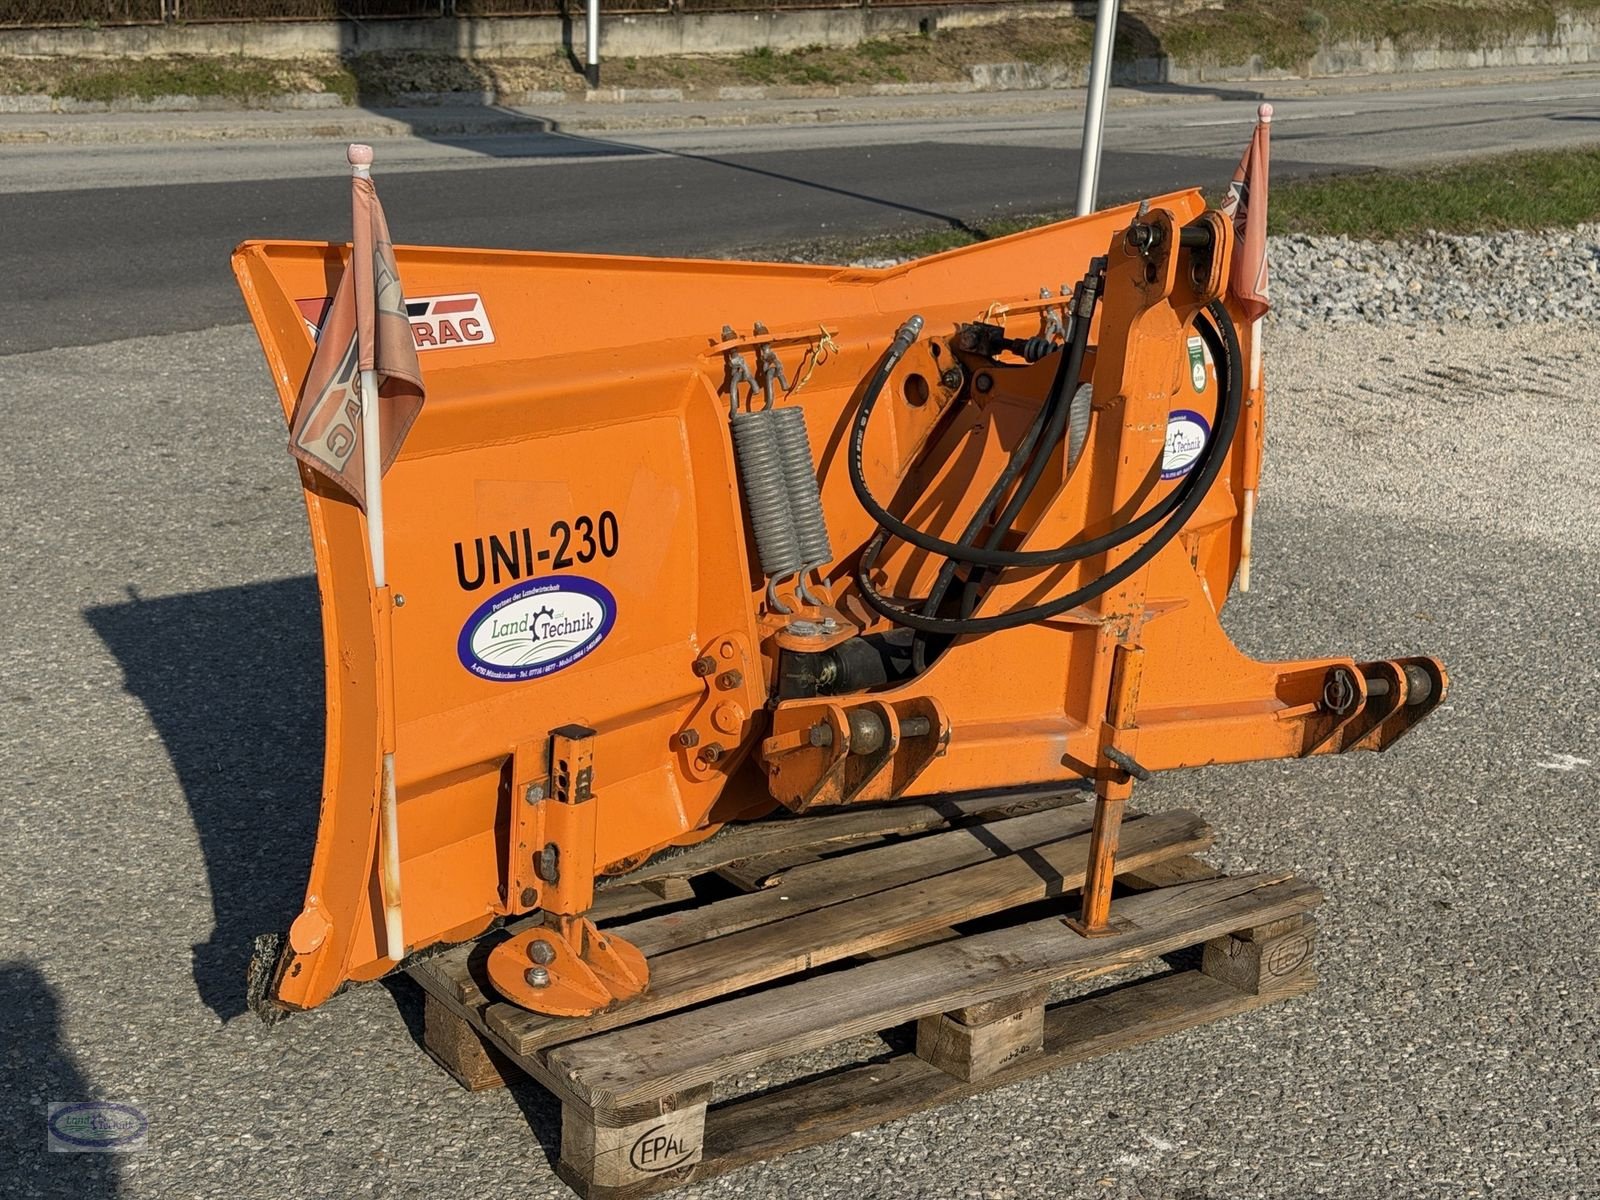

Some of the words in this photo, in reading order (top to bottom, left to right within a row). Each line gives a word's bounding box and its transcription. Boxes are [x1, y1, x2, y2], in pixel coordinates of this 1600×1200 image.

[411, 318, 484, 346] RAC
[454, 511, 618, 591] UNI-230
[492, 597, 512, 611] Partner
[512, 593, 522, 601] der
[522, 584, 560, 597] Landwirtschaft
[491, 613, 529, 640] Land
[541, 612, 594, 640] Technik
[640, 1133, 690, 1165] EPAL
